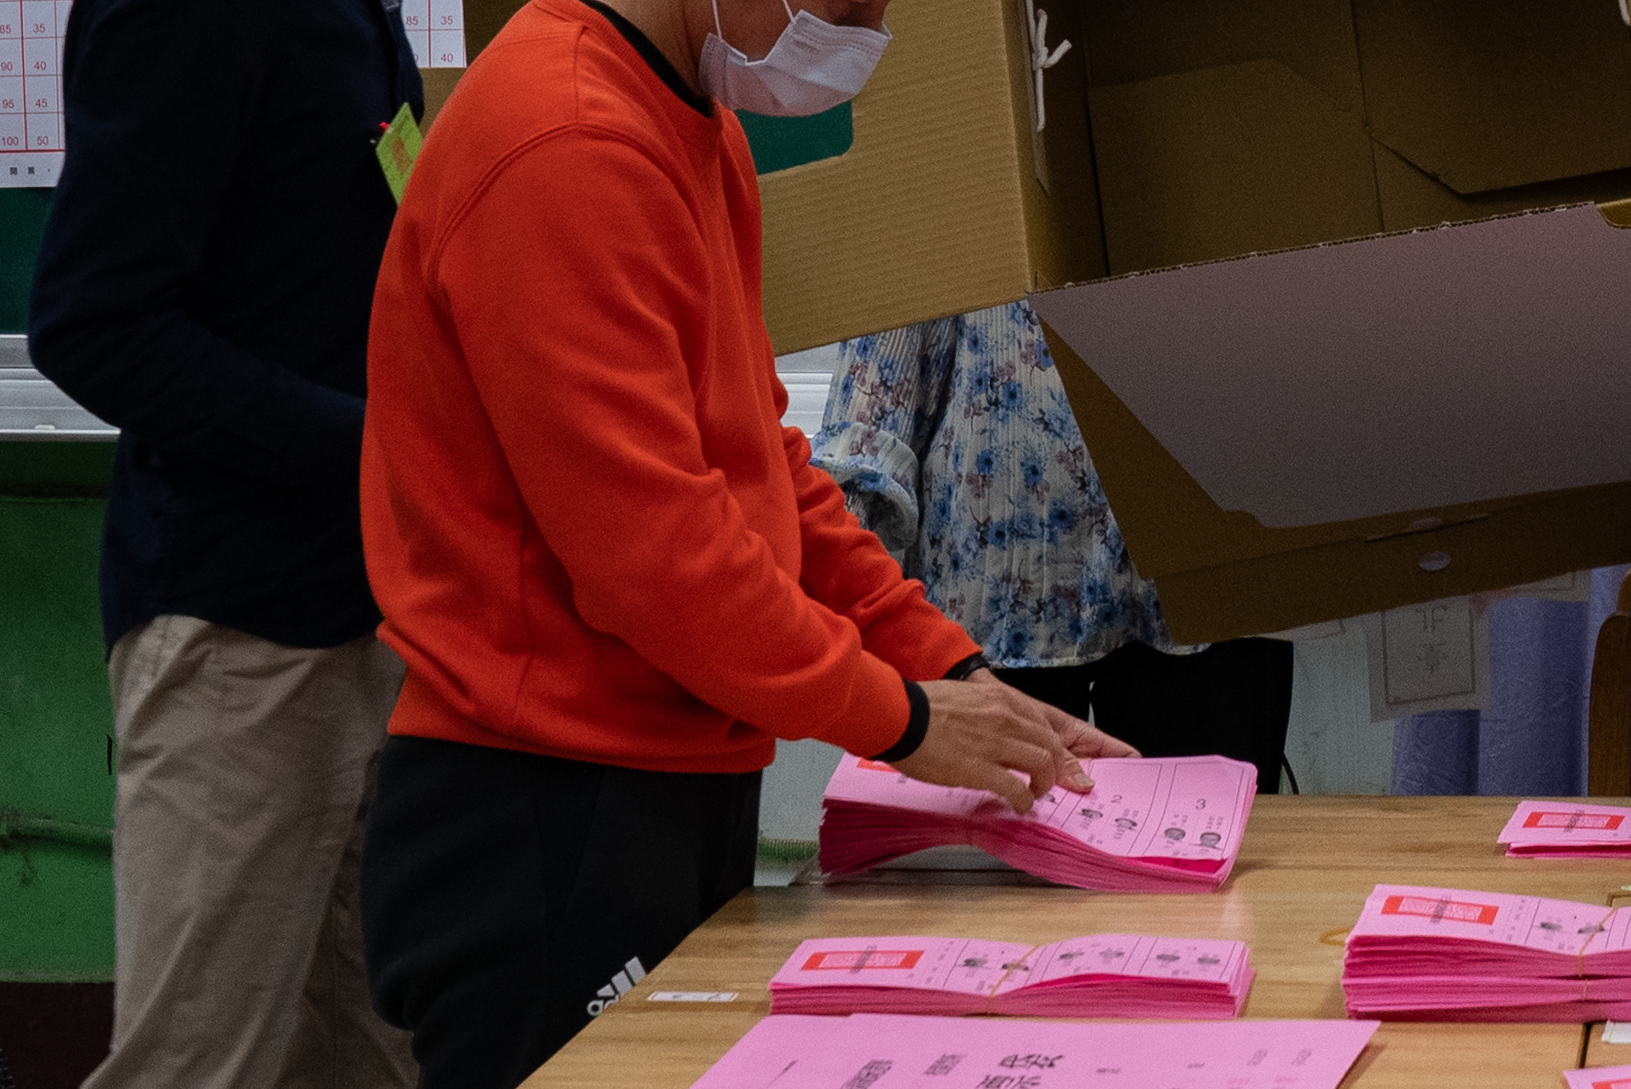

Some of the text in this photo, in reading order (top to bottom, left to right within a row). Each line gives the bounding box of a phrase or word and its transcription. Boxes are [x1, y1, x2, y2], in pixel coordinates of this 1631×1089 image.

[406, 15, 419, 26] 85
[440, 15, 454, 26] 35
[34, 24, 46, 34] 35
[440, 52, 454, 63] 40
[0, 62, 12, 71] 90
[34, 61, 46, 70] 40
[2, 99, 14, 108] 95
[35, 98, 48, 108] 45
[2, 136, 19, 146] 100
[37, 136, 49, 146] 50
[1195, 798, 1206, 810] 3
